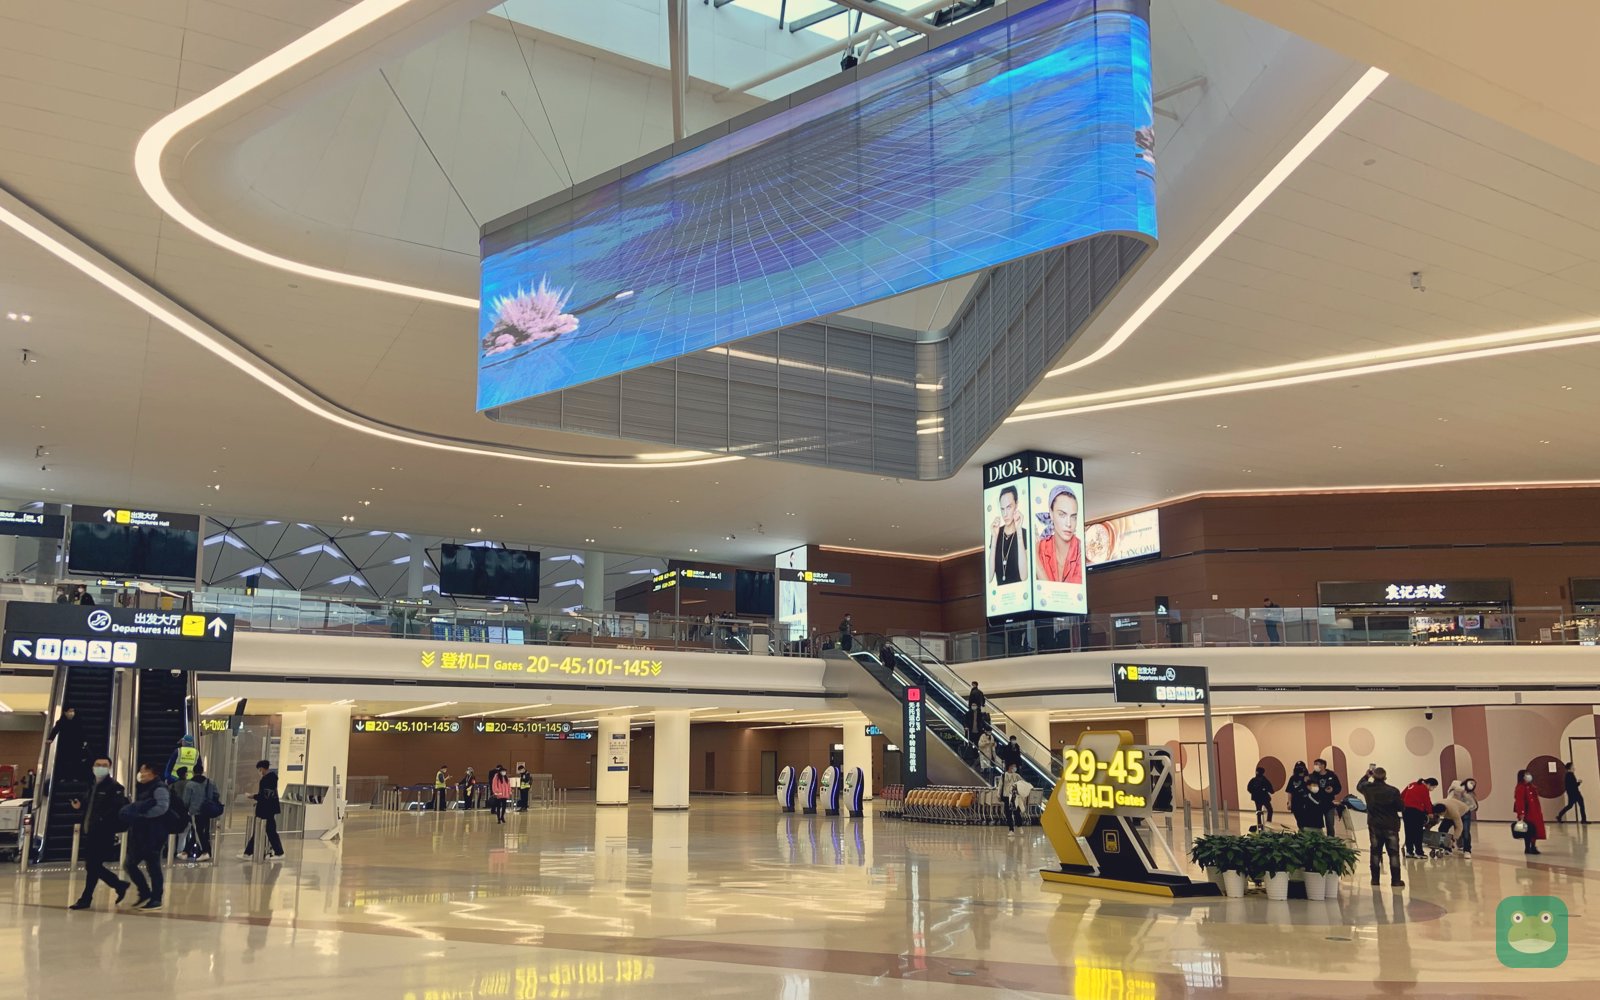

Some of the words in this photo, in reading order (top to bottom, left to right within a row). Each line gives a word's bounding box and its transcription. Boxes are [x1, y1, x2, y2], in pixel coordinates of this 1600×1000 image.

[989, 459, 1023, 483] DIOR
[1036, 457, 1076, 477] DIOR
[134, 613, 181, 626] 出发大厅
[112, 624, 161, 634] Departures
[163, 627, 181, 635] Hall
[440, 652, 490, 670] 登机口
[494, 660, 523, 671] Gates
[526, 655, 650, 677] 20-45,101-145
[375, 721, 450, 732] 20-45,101-145
[494, 722, 562, 733] 20-45,101-145
[1064, 749, 1145, 785] 29-45
[1066, 782, 1114, 809] 登机口
[1115, 790, 1145, 807] Gates
